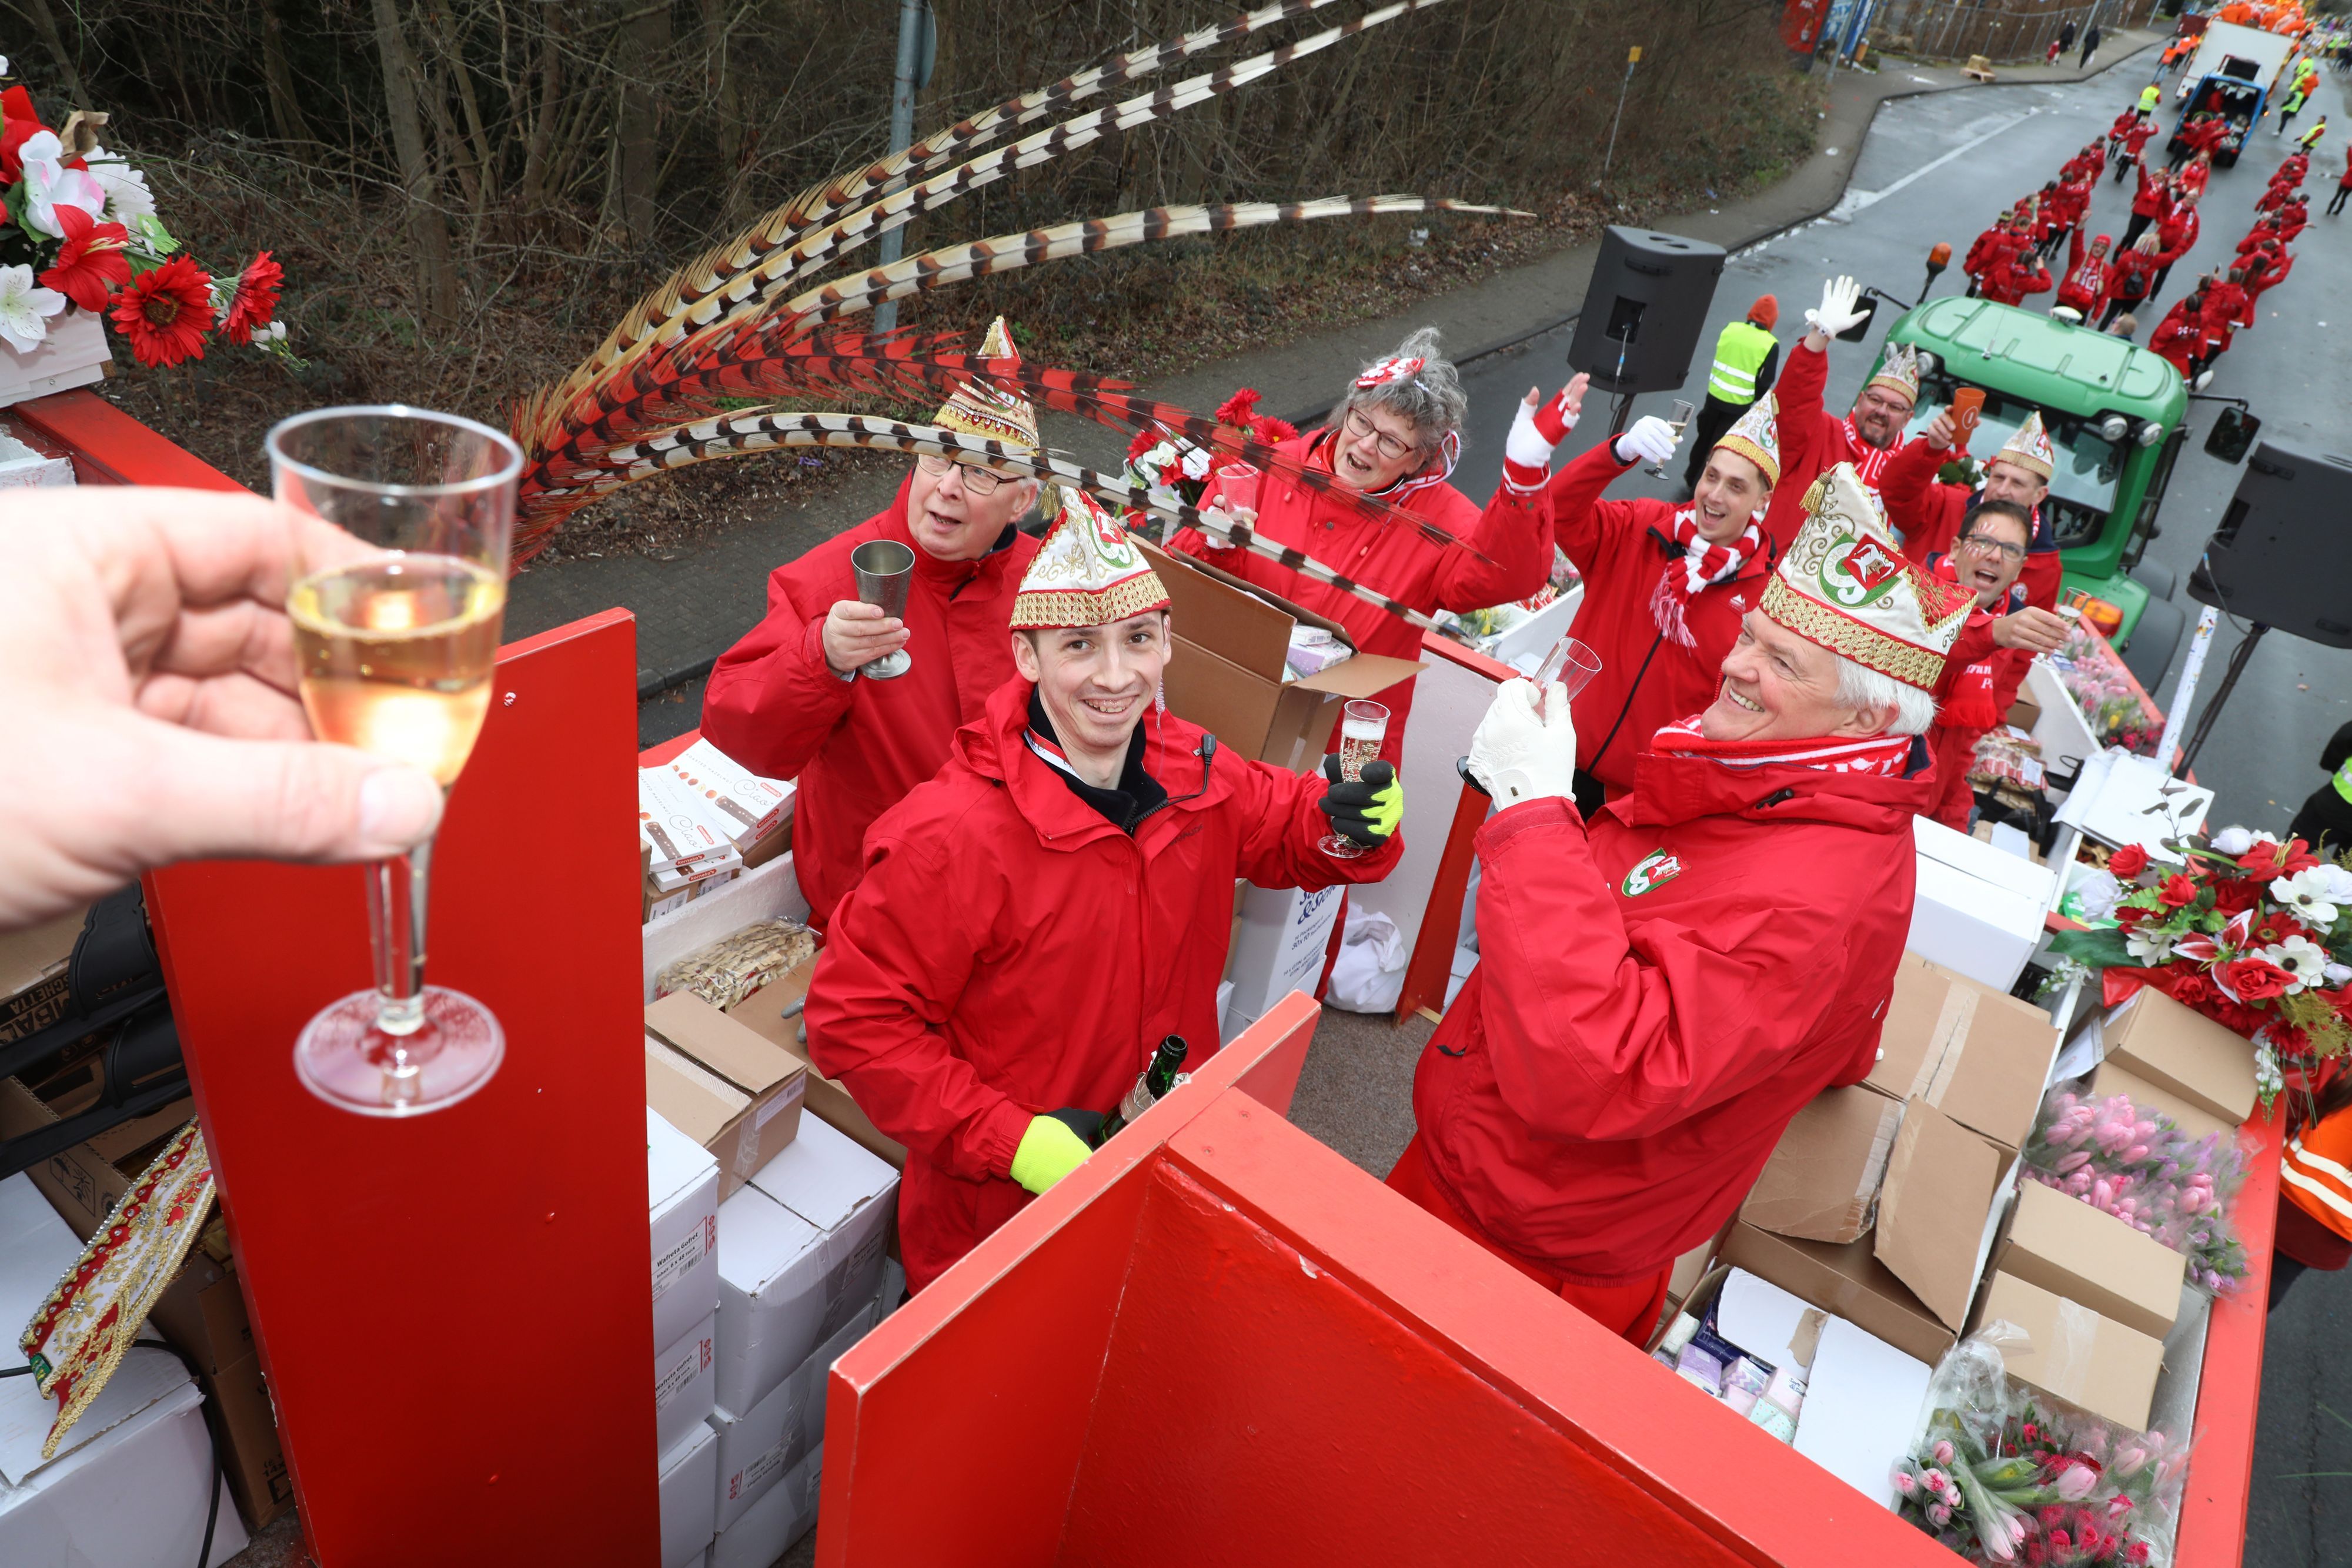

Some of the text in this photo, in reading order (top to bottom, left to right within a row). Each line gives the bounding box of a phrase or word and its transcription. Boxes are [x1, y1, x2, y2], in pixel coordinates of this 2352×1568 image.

[733, 779, 770, 806] Ciao
[669, 815, 698, 848] Ciao
[657, 1232, 698, 1267] Wafreta Gofret
[655, 1355, 692, 1392] Wafreta Gofret
